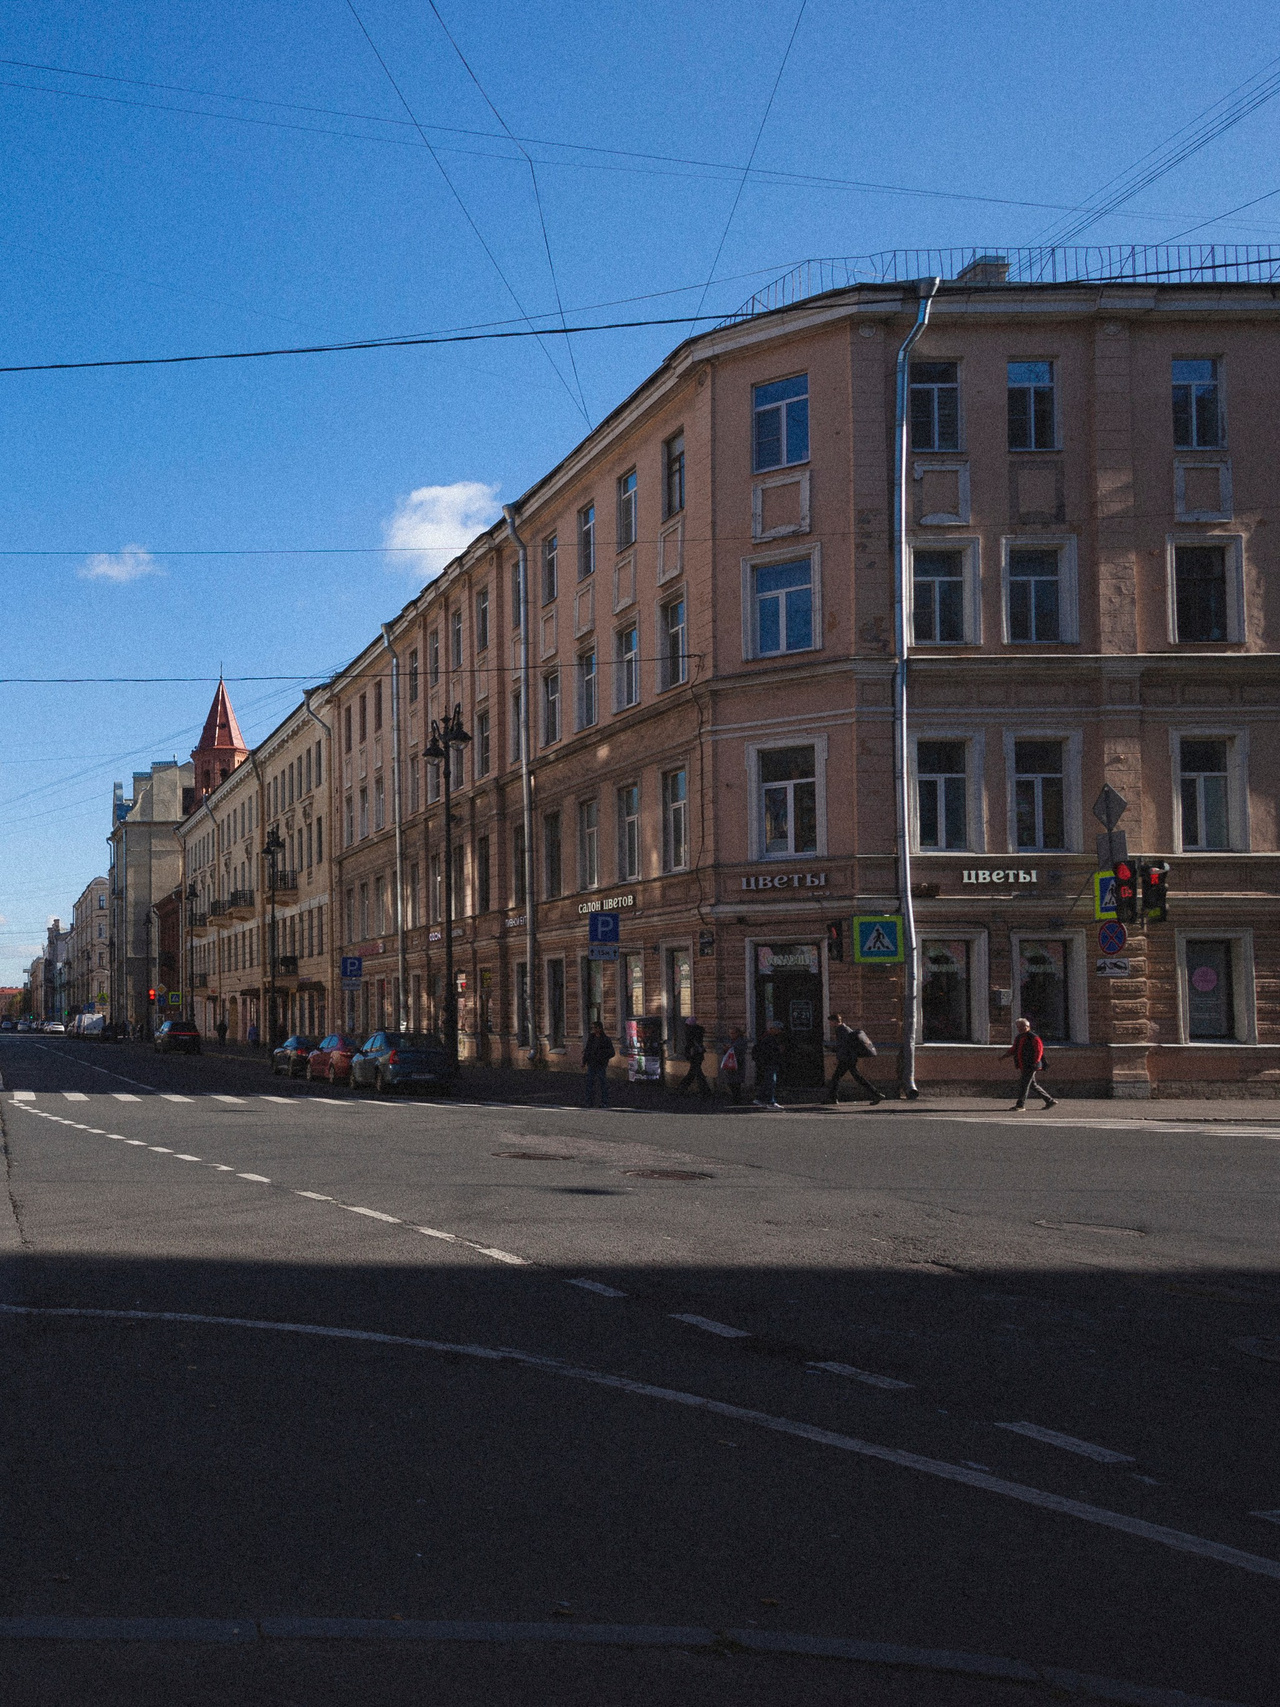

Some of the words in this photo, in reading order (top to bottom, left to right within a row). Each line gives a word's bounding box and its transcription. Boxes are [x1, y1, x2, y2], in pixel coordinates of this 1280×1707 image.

[741, 873, 826, 890] цветы
[962, 869, 1038, 884] цветы
[603, 895, 634, 910] цветов
[597, 916, 614, 939] P
[347, 959, 359, 975] P
